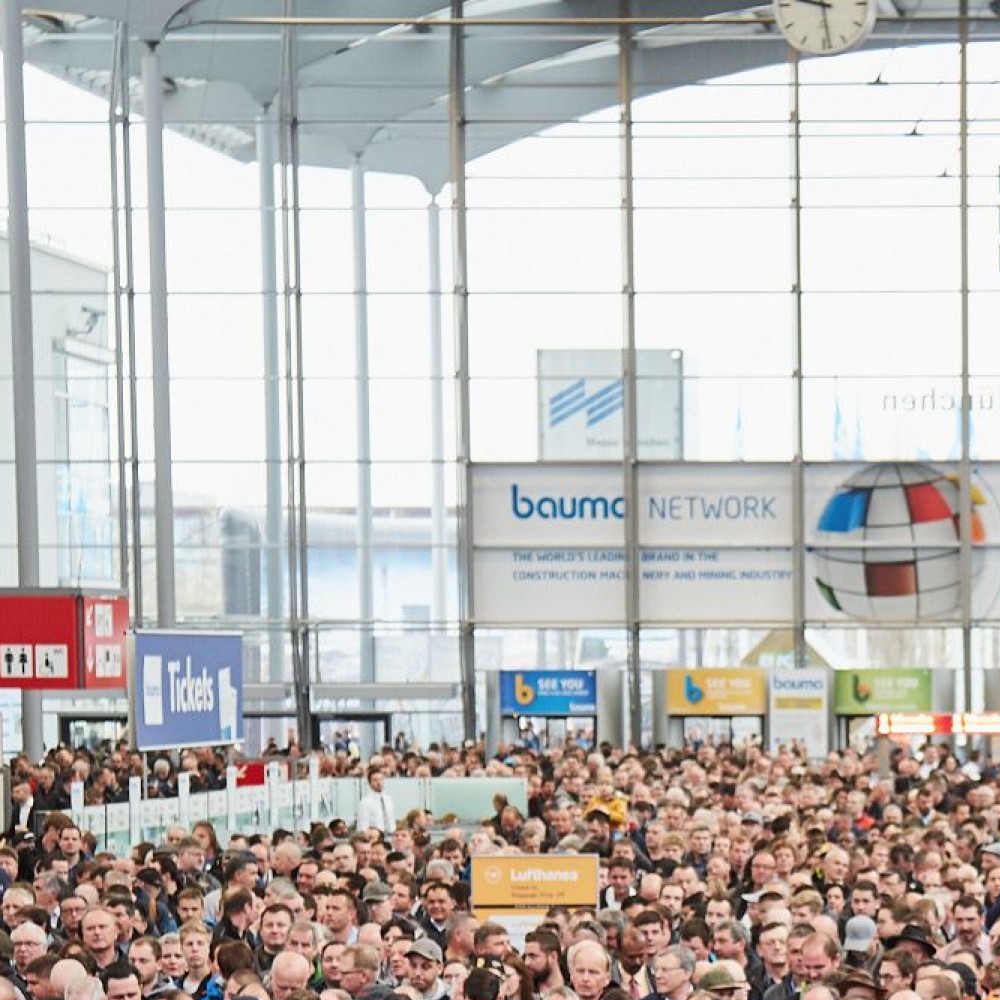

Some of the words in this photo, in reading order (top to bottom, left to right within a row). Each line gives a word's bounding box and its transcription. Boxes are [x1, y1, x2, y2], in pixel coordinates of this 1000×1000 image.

[648, 496, 777, 520] NETWORK
[513, 552, 533, 562] THE
[537, 552, 584, 562] WORLD'S
[642, 551, 679, 562] BRAND
[684, 551, 694, 561] IN
[698, 551, 718, 561] THE
[513, 571, 595, 580] CONSTRUCTION
[674, 570, 696, 580] AND
[699, 570, 736, 579] MINING
[740, 570, 792, 579] INDUSTRY
[168, 655, 213, 713] Tickets
